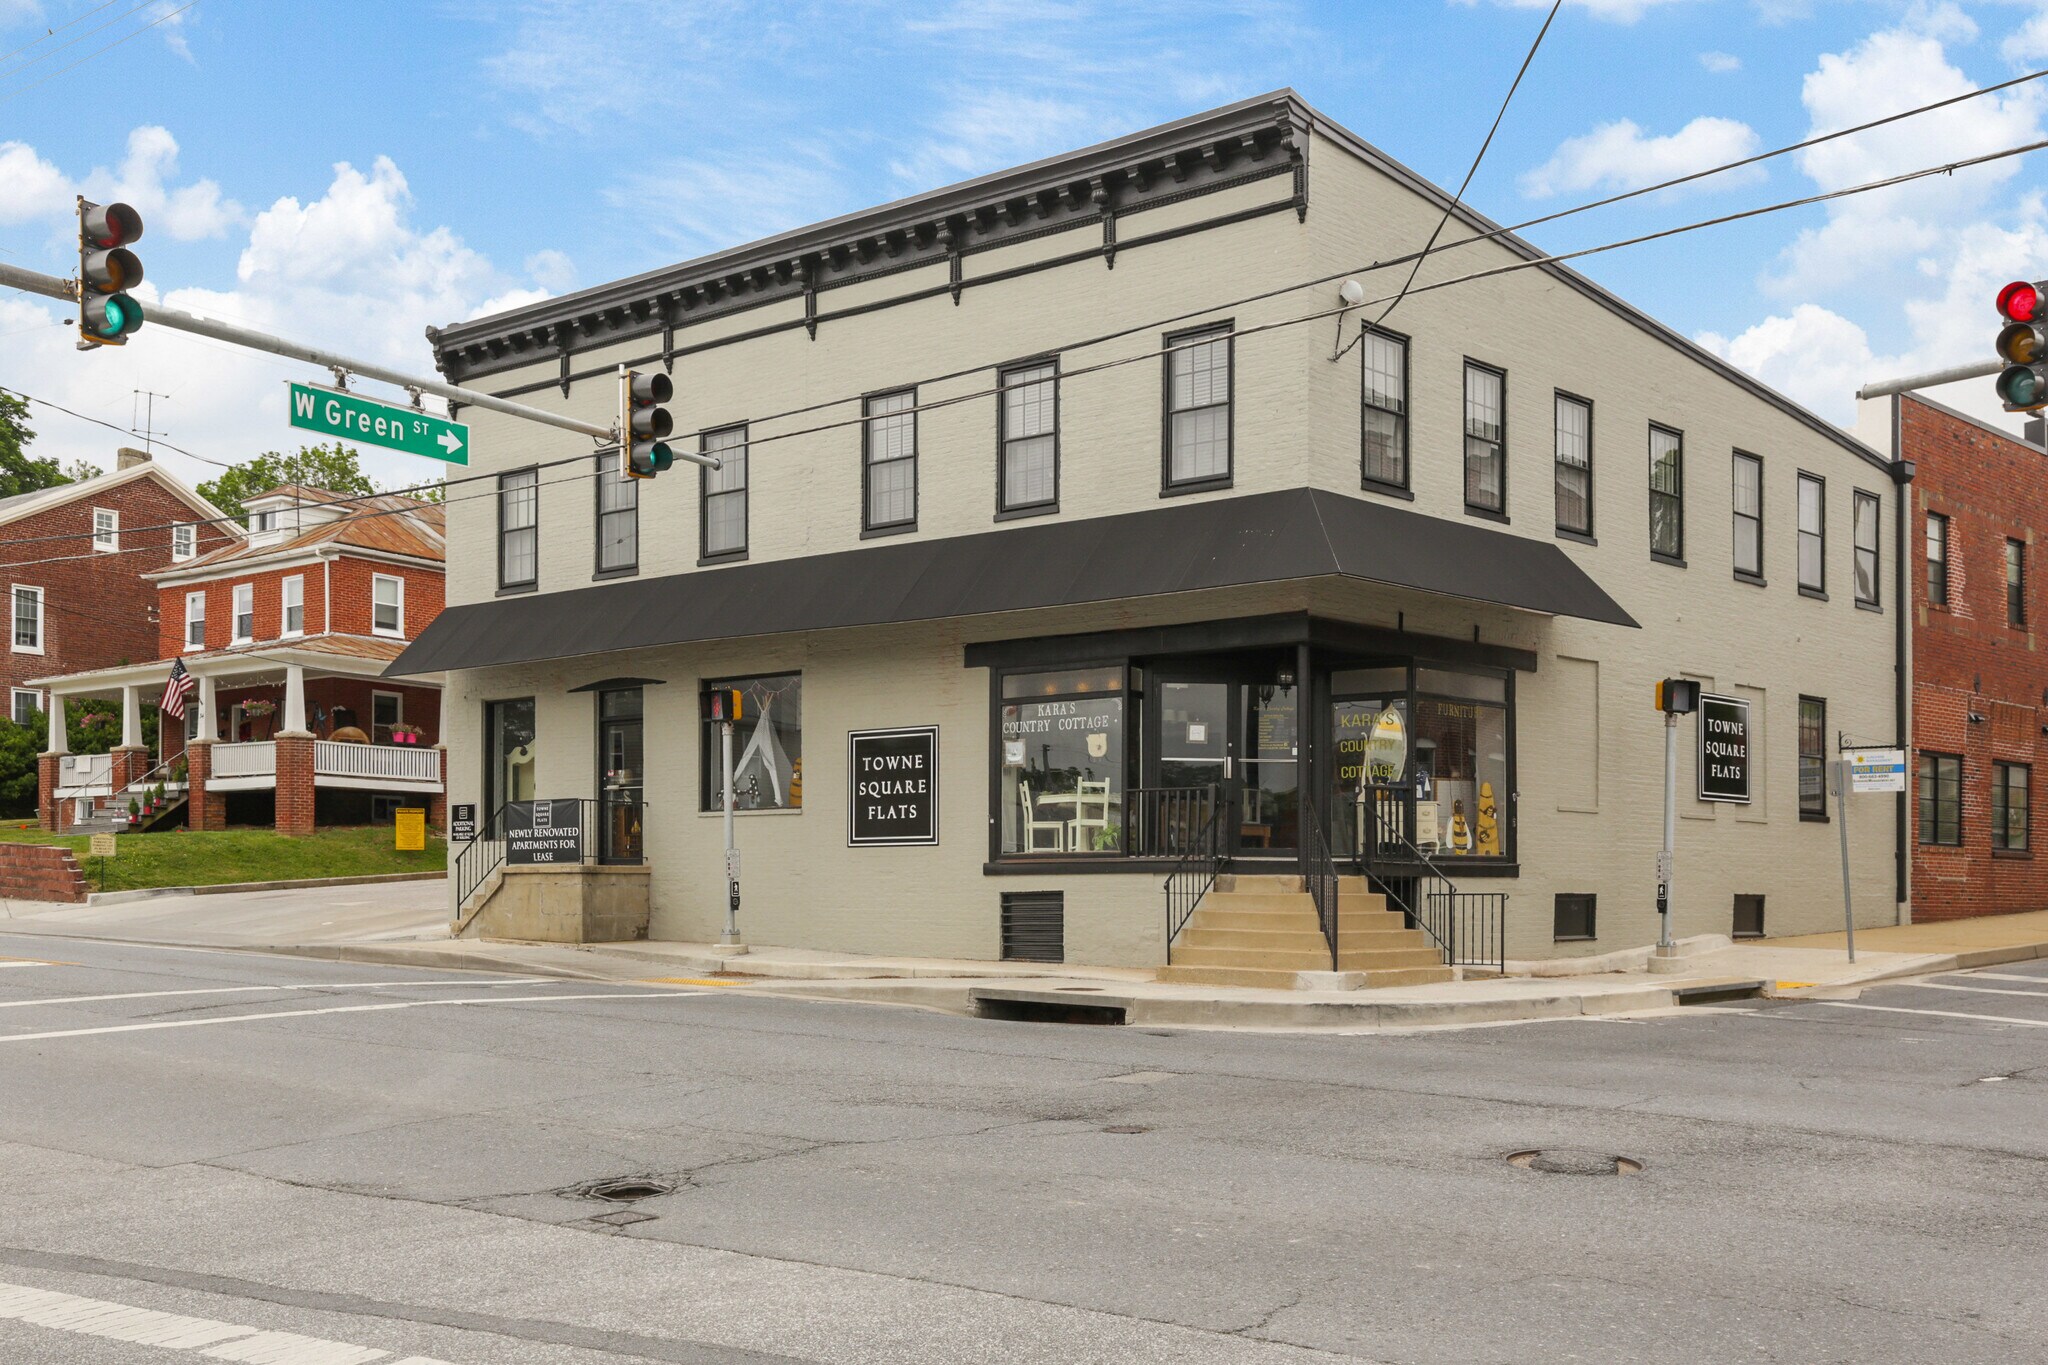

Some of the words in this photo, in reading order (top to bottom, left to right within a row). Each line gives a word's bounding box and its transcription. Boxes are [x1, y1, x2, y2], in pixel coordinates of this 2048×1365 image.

[295, 391, 315, 419] W
[325, 400, 404, 441] Green
[413, 420, 429, 436] ST
[1038, 702, 1076, 717] KARA'S
[1003, 719, 1051, 734] COUNTRY
[1058, 715, 1109, 730] COTTAGE
[1341, 712, 1395, 728] KARA'S
[1708, 718, 1744, 736] TOWNE
[1340, 739, 1396, 753] COUNTRY
[1705, 741, 1746, 759] SQUARE
[862, 754, 923, 770] TOWNE
[1853, 766, 1870, 774] FOR
[1872, 765, 1895, 773] RENT
[1340, 764, 1396, 779] COTTAGE
[1711, 764, 1741, 779] FLATS
[859, 779, 926, 798] SQUARE
[868, 804, 917, 820] FLATS
[509, 828, 533, 839] NEWLY
[534, 826, 579, 838] RENOVATED
[511, 840, 558, 850] APARTMENTS
[559, 839, 576, 849] FOR
[533, 852, 554, 862] LEASE
